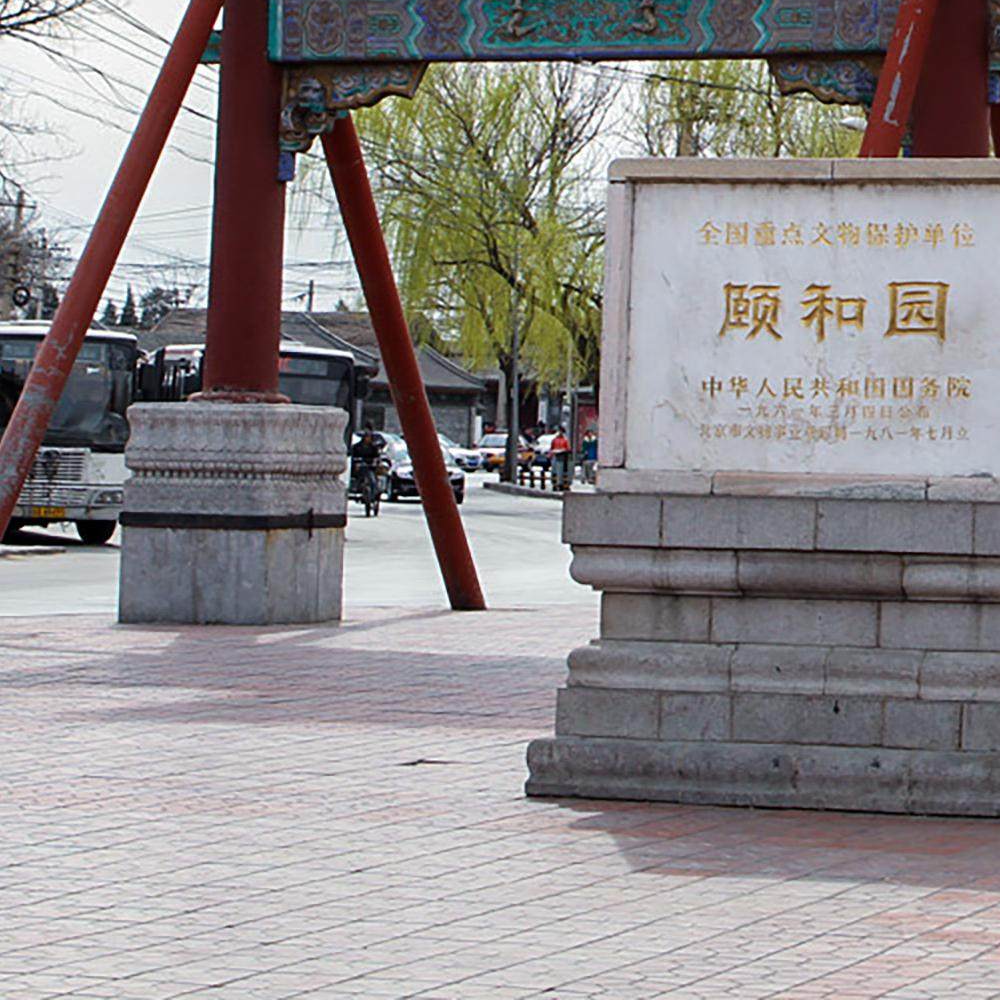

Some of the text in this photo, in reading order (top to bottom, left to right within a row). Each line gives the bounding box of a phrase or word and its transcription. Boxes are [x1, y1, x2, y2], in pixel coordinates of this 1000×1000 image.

[698, 220, 977, 248] 全国重点文物保护单位
[718, 281, 950, 342] 颐和园
[701, 375, 973, 399] 中华人民共和国国务院
